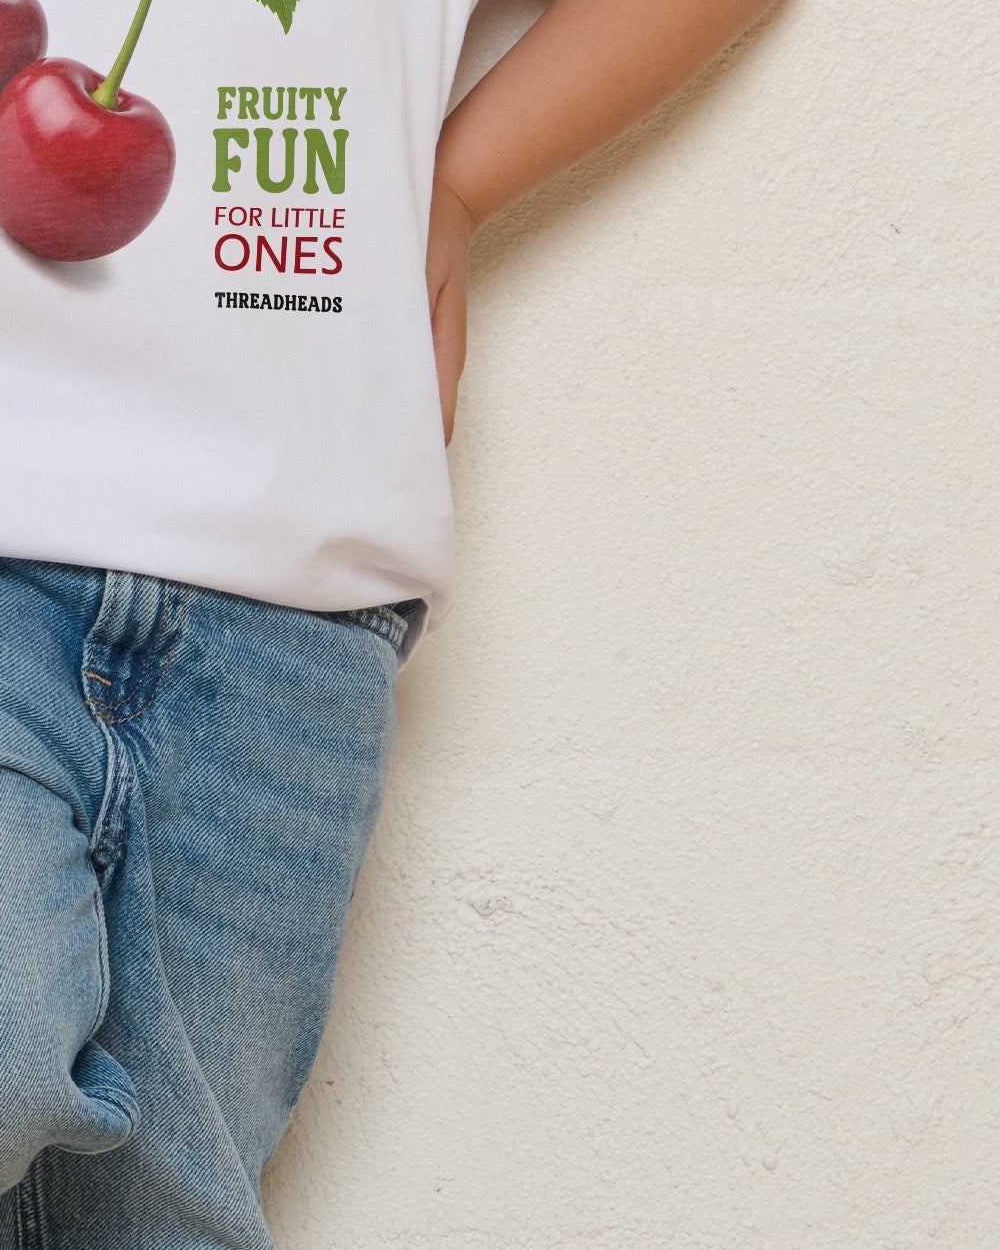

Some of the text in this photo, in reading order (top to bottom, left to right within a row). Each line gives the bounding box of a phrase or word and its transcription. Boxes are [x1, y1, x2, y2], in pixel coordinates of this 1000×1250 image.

[216, 86, 348, 122] FRUITY
[211, 127, 350, 195] FUN
[214, 206, 346, 229] FOR LITTLE
[214, 233, 343, 276] ONES
[214, 291, 343, 314] THREADHEADS
